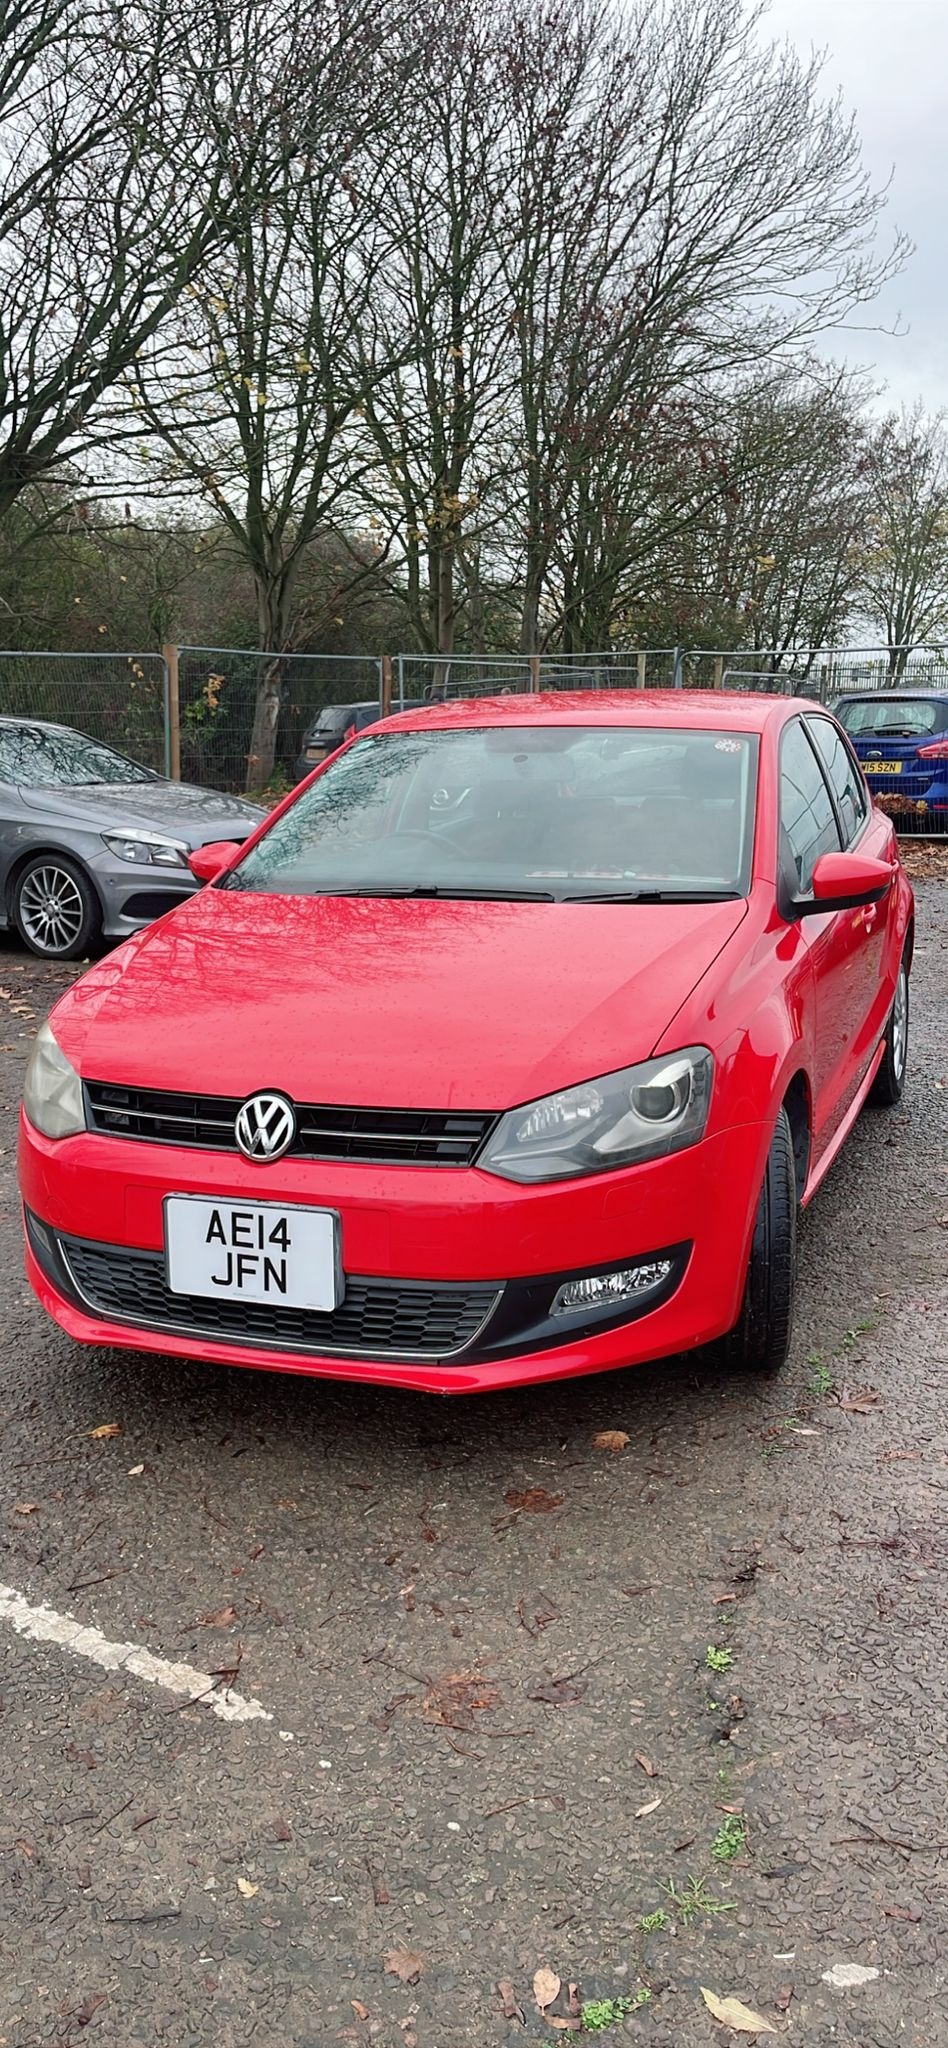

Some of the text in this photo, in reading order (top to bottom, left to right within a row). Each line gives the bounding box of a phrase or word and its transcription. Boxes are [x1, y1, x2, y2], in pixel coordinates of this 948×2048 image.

[877, 762, 897, 772] SZN
[235, 1094, 295, 1161] VW
[205, 1209, 291, 1253] AE14
[211, 1252, 287, 1294] JFN
